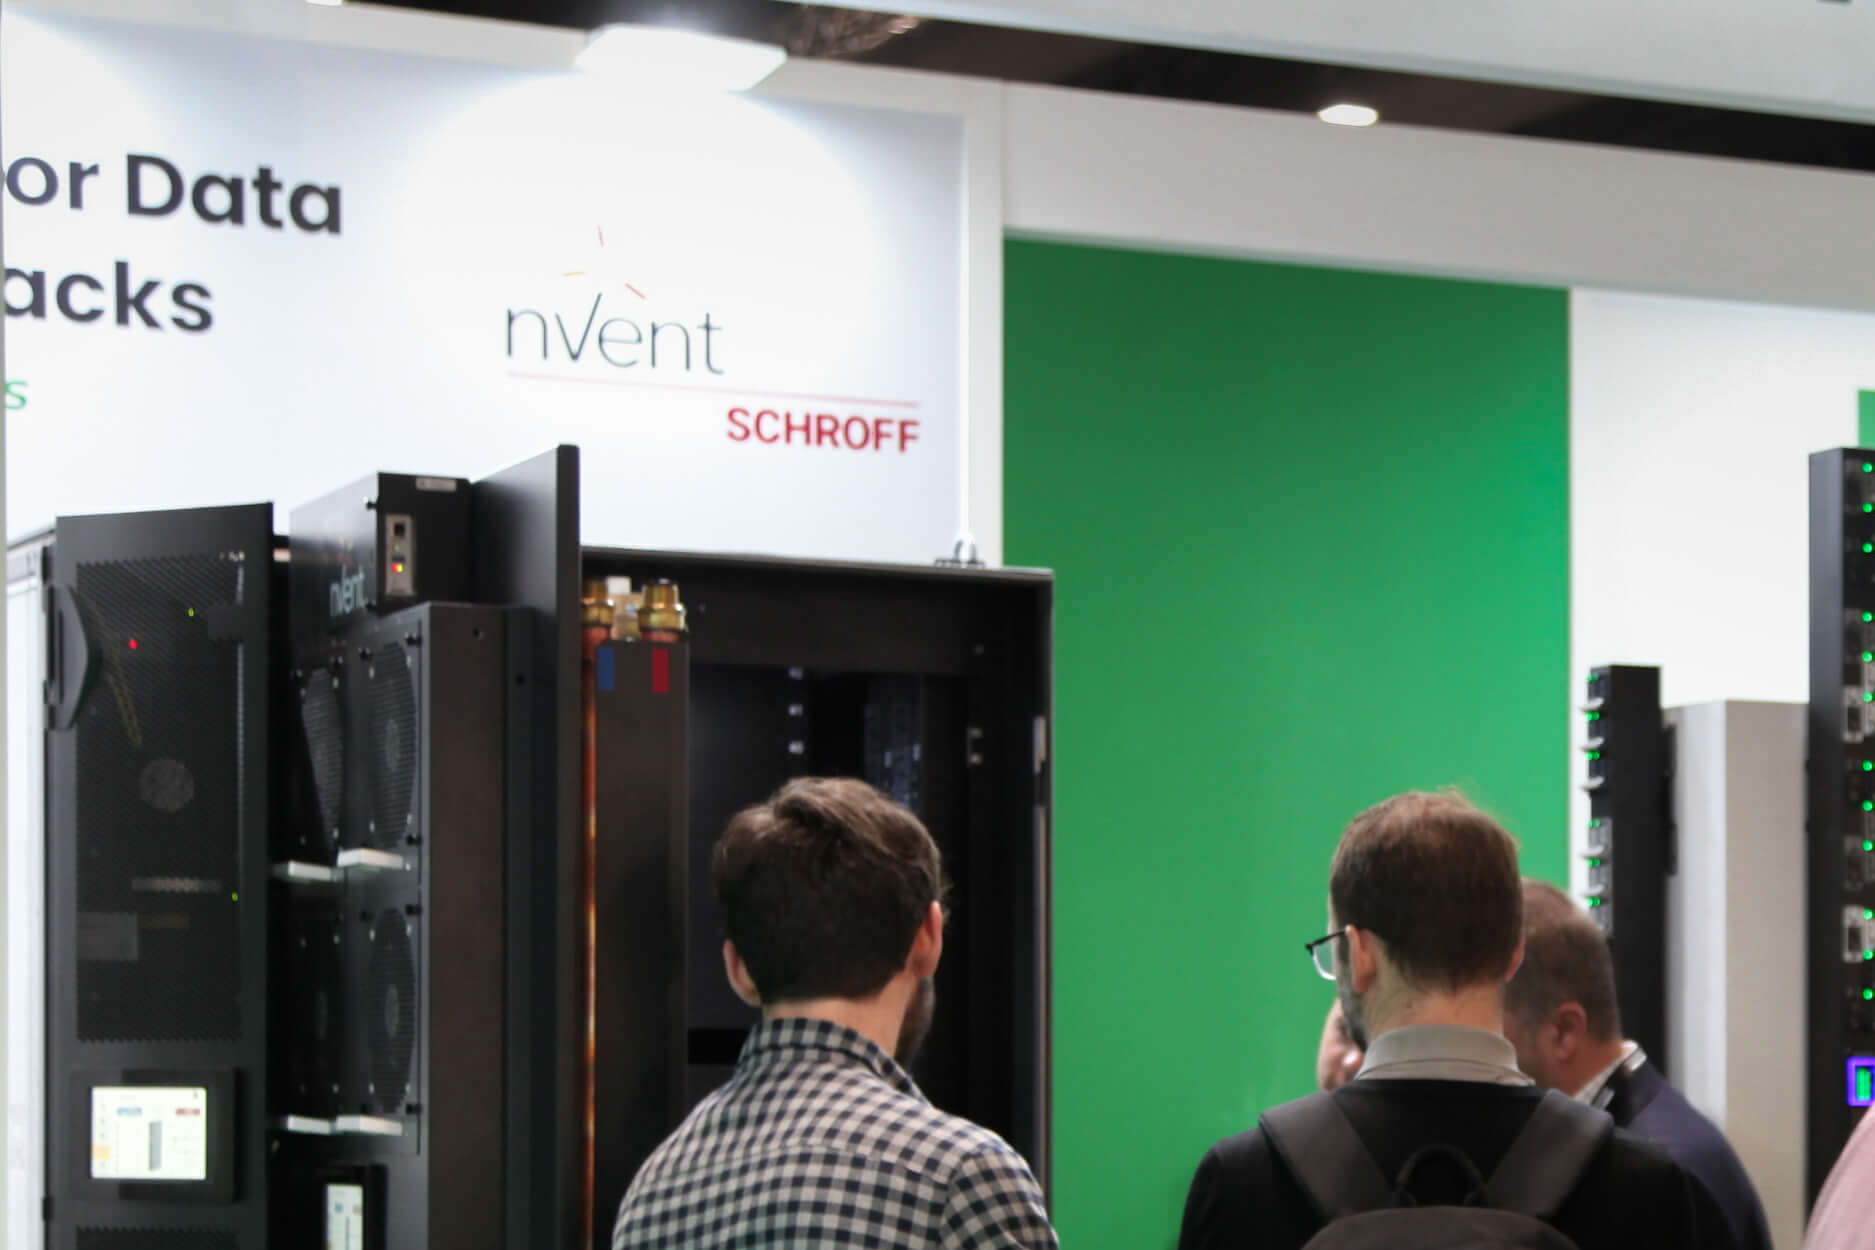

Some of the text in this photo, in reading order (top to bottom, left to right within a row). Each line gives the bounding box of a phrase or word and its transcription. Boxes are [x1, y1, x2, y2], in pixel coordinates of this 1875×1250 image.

[0, 153, 342, 236] or Data
[726, 406, 920, 453] SCHROFF
